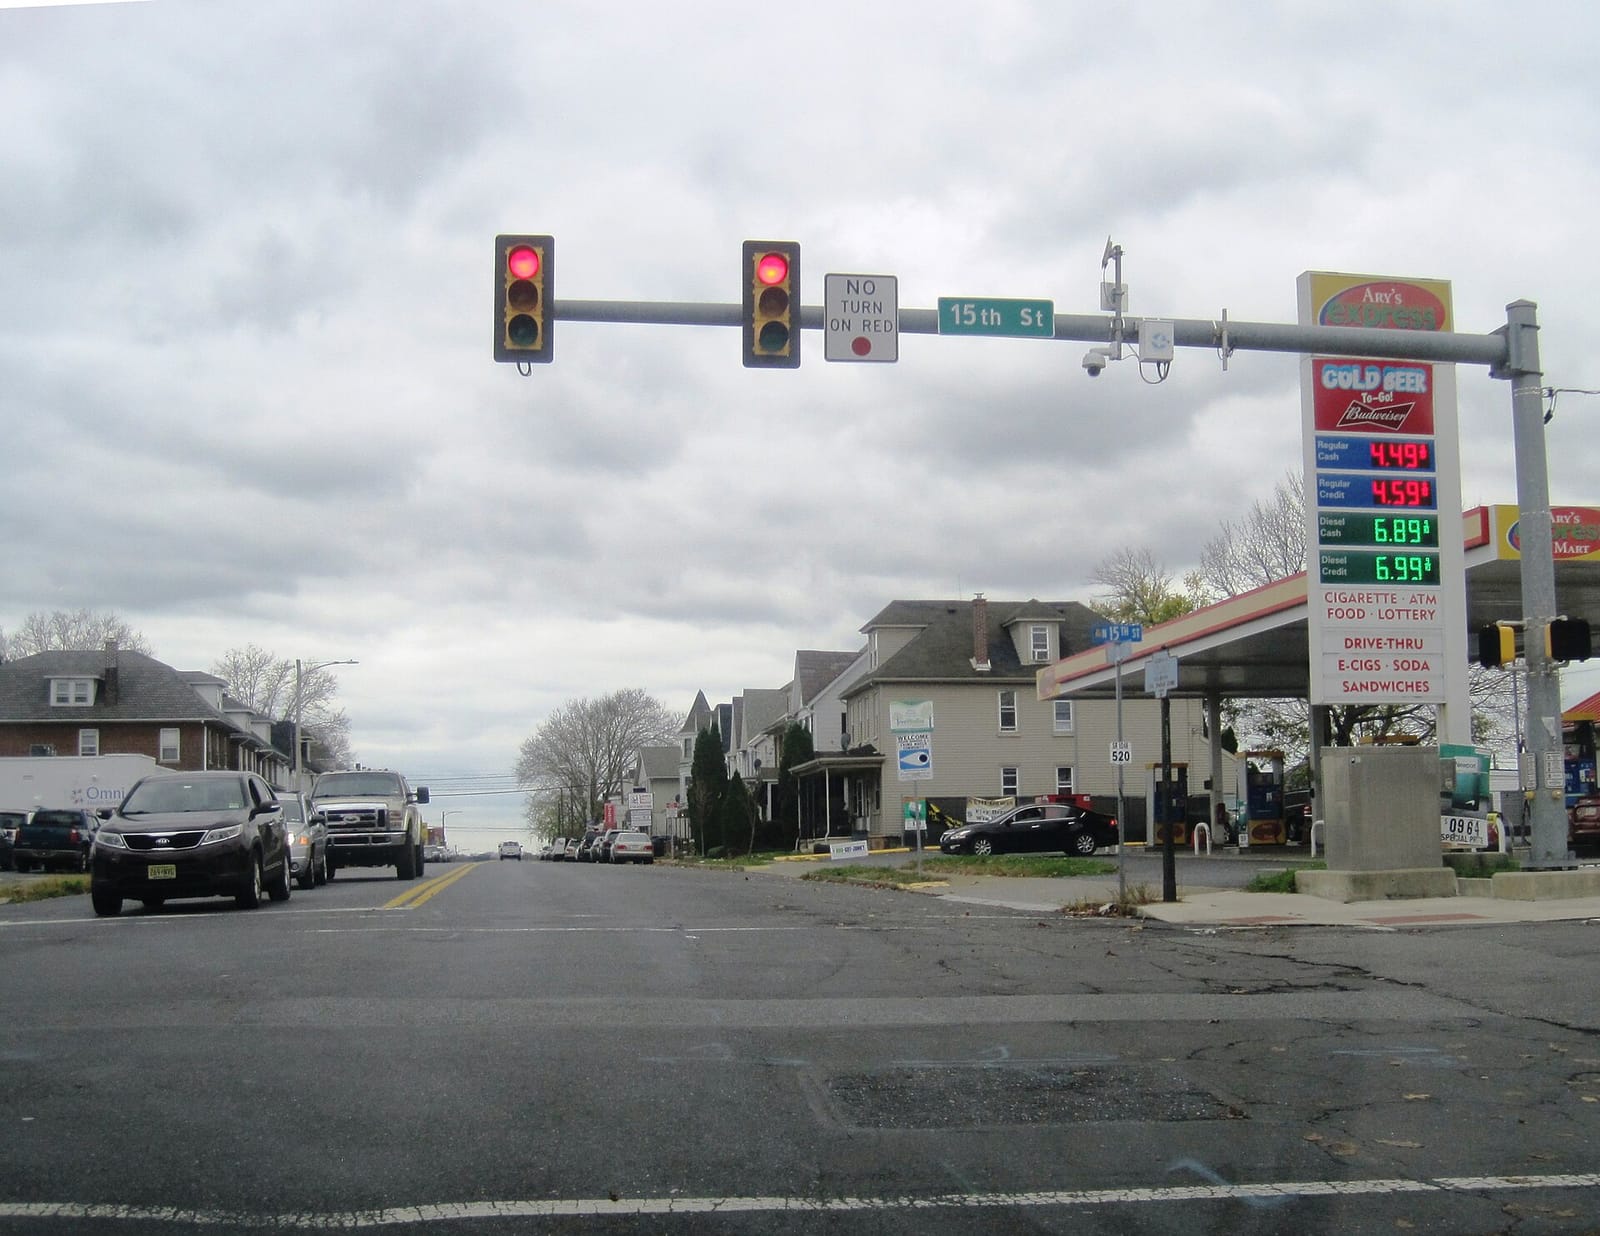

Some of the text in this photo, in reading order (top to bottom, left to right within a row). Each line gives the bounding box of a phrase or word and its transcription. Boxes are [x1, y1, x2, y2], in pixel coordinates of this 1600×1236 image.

[846, 279, 876, 296] NO
[841, 300, 883, 314] TURN
[951, 303, 1044, 327] 15th St
[1327, 302, 1436, 330] express
[830, 318, 893, 333] ON RED
[1321, 364, 1427, 394] COLD BEER
[1346, 406, 1406, 421] Budweiser
[1317, 440, 1349, 450] Regular
[1318, 452, 1339, 461] Cash
[1319, 478, 1350, 489] Regular
[1319, 490, 1345, 500] Credit
[1320, 516, 1345, 526] Diesel
[1320, 528, 1342, 537] Cash
[1321, 555, 1347, 565] Diesel
[1321, 566, 1347, 576] Credit
[1324, 591, 1437, 605] CIGARETTE ATM
[1327, 608, 1436, 620] FOOD LOTTERY
[1344, 638, 1424, 650] DRIVE-THRU
[1338, 659, 1430, 671] E-CIGS SODA
[1342, 680, 1430, 693] SANDWICHES
[1112, 751, 1130, 761] 520
[86, 786, 125, 800] Omni
